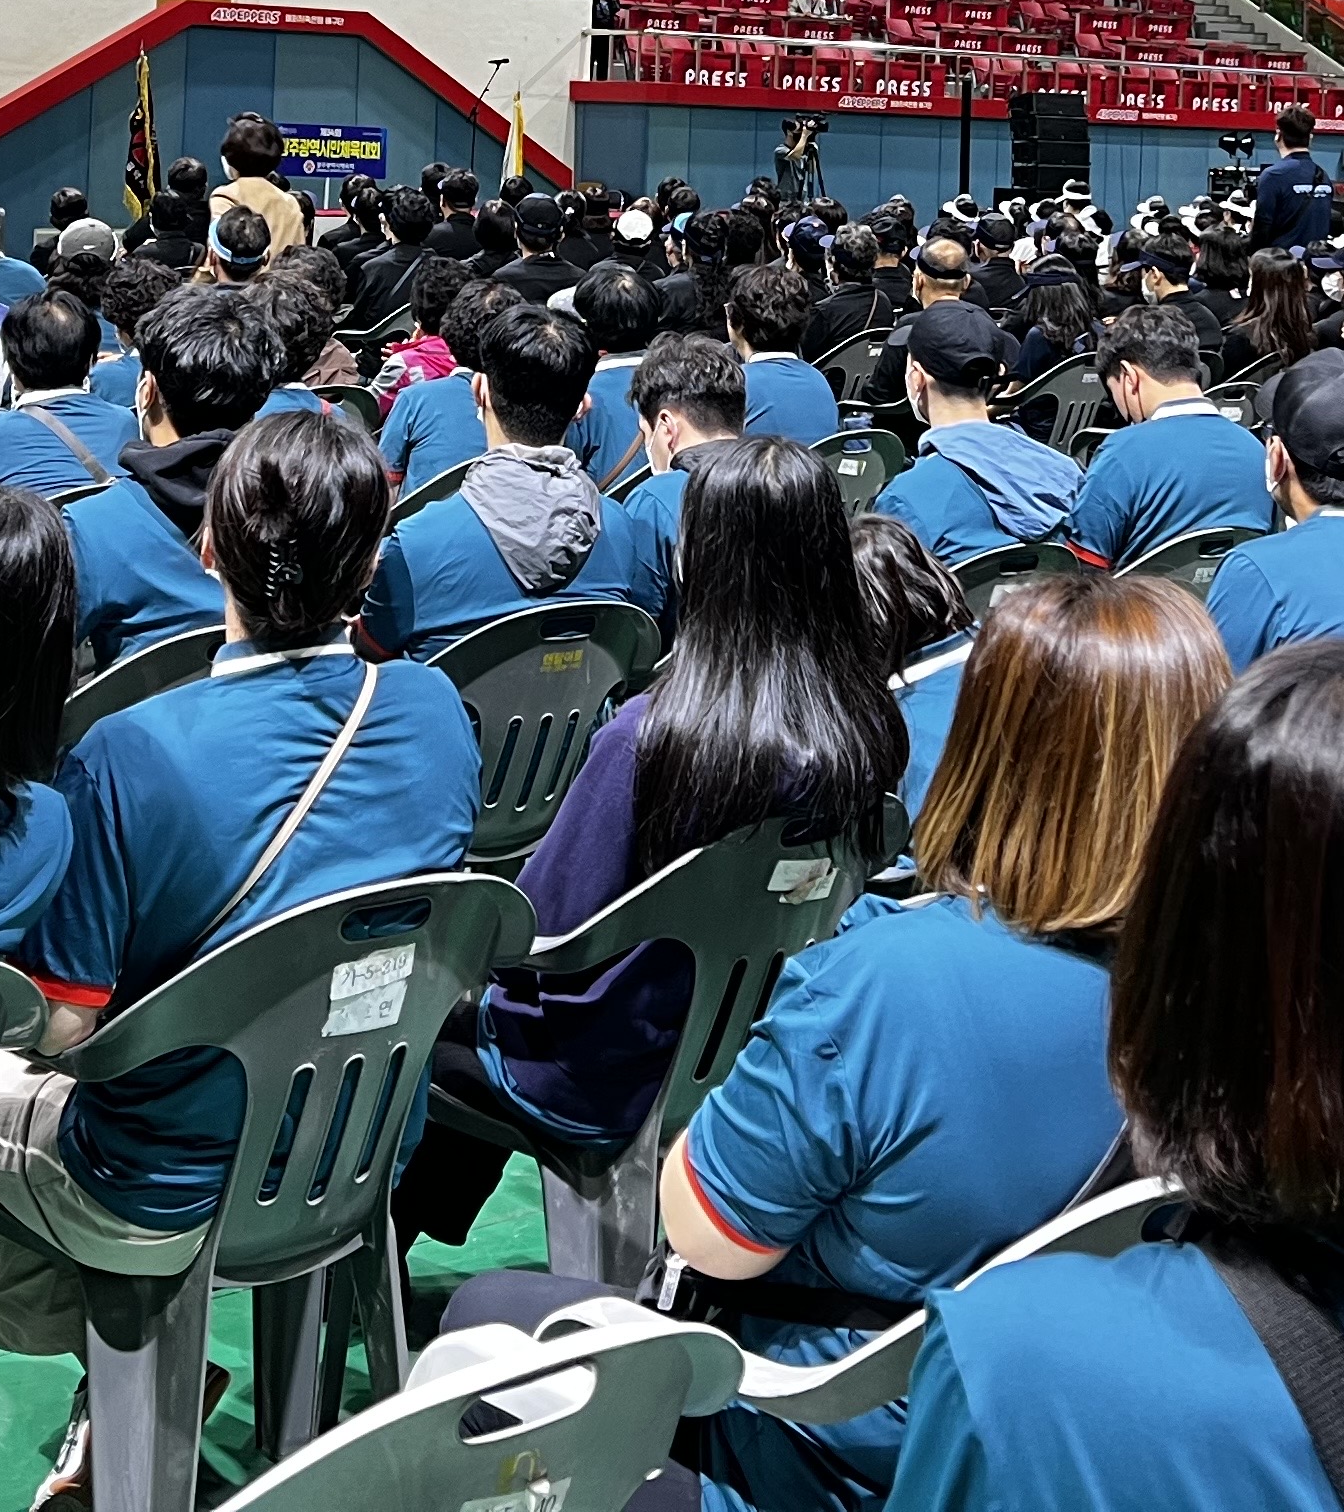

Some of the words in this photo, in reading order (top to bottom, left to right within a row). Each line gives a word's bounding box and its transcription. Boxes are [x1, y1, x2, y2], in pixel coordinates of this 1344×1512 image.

[904, 5, 932, 16] PRESS
[964, 10, 992, 20] PRESS
[646, 18, 680, 30] PRESS
[733, 24, 765, 35] PRESS
[1092, 20, 1118, 30] PRESS
[1148, 24, 1173, 34] PRESS
[804, 29, 835, 40] PRESS
[954, 39, 982, 50] PRESS
[1015, 43, 1042, 54] PRESS
[1138, 52, 1163, 62] PRESS
[1215, 57, 1240, 67] PRESS
[1267, 60, 1291, 70] PRESS
[684, 68, 749, 88] PRESS
[875, 79, 933, 97] PRESS
